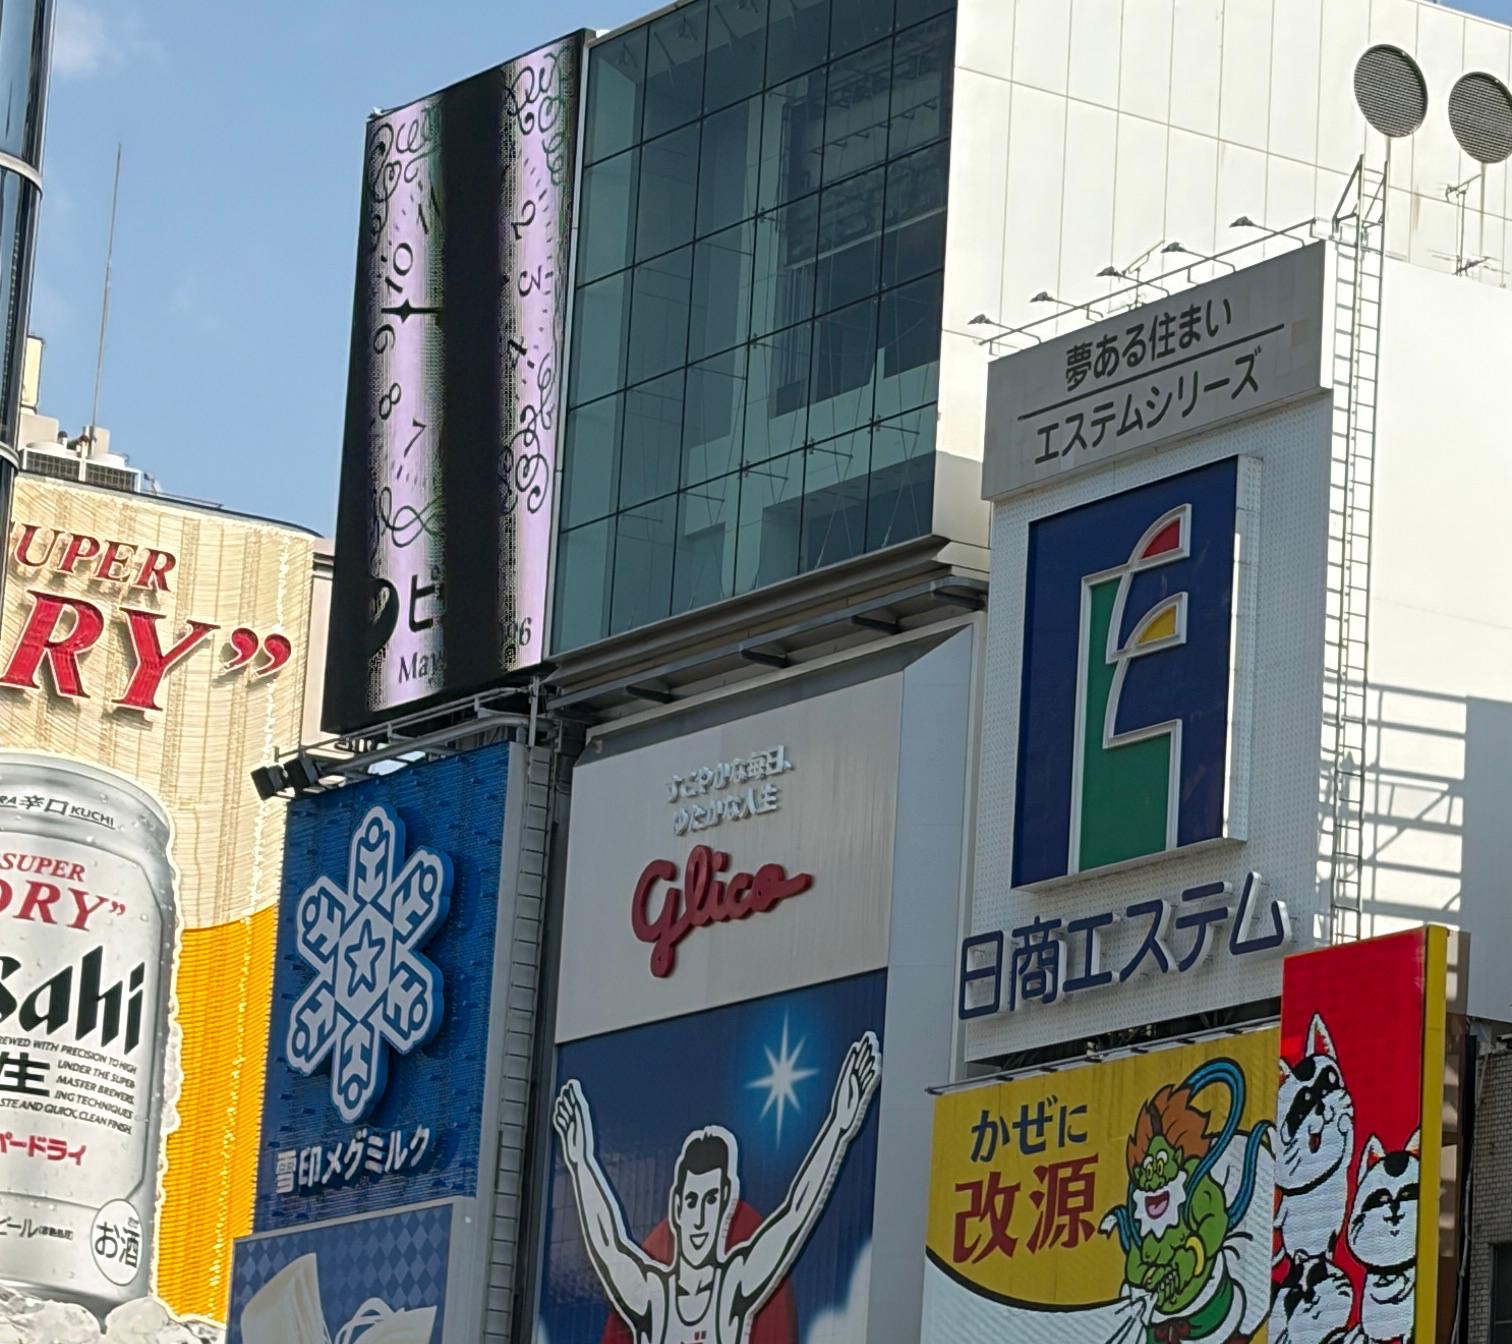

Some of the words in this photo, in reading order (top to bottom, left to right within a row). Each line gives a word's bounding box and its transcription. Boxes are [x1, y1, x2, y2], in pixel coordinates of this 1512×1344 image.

[511, 199, 536, 240] 2
[385, 242, 414, 293] 10
[518, 265, 542, 297] 3
[1065, 297, 1233, 393] 夢ある住まい
[379, 383, 401, 420] 8
[1034, 347, 1263, 465] エステムシリーズ
[404, 418, 426, 458] 7
[11, 520, 177, 593] UPER
[19, 794, 68, 816] 辛口
[70, 805, 115, 829] KUCHI
[632, 844, 814, 978] Glico
[958, 872, 1289, 1021] 日商エステム
[0, 1051, 50, 1097] 生
[33, 1040, 59, 1052] WITH
[60, 1045, 107, 1062] PRECISION
[58, 1060, 91, 1074] UNDER
[93, 1067, 111, 1080] THE
[55, 1090, 75, 1102] ING
[76, 1094, 134, 1120] TECHNIQUES
[56, 1075, 97, 1091] MASTER
[20, 1099, 43, 1111] AND
[79, 1111, 107, 1125] CLEAN
[970, 1095, 1088, 1163] かぜに
[274, 1125, 430, 1195] 雪印メグミルク
[953, 1153, 1099, 1264] 改源
[95, 1221, 140, 1268] お酒
